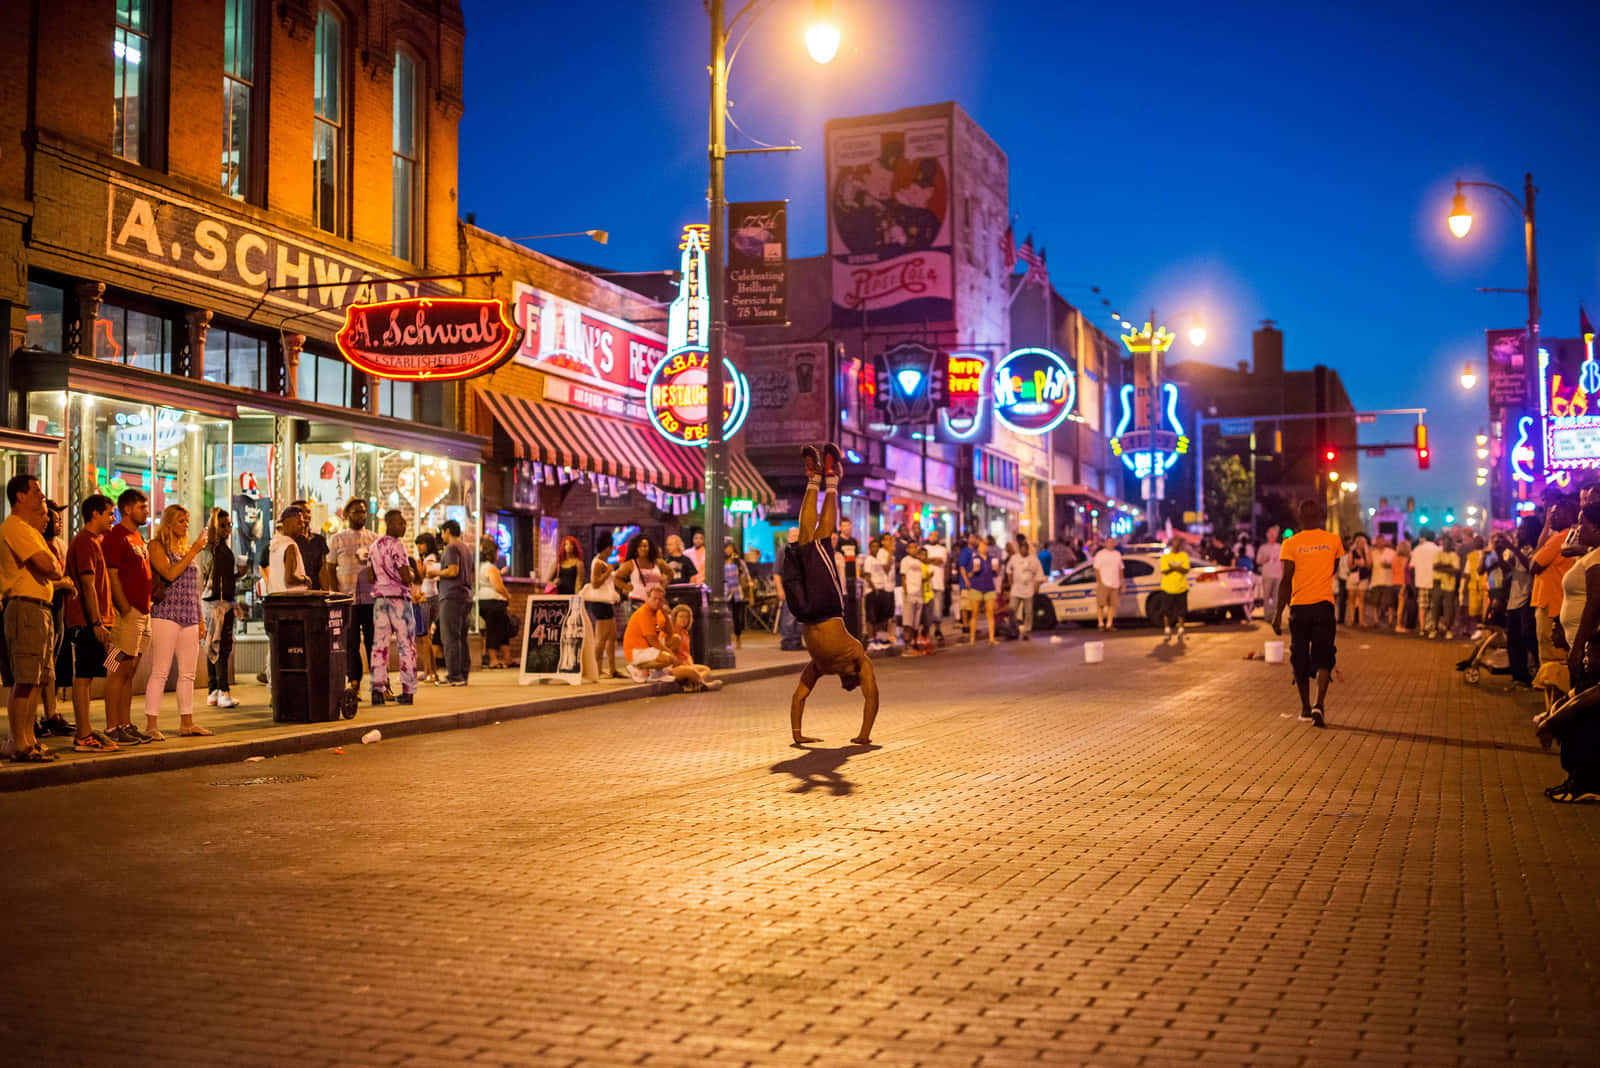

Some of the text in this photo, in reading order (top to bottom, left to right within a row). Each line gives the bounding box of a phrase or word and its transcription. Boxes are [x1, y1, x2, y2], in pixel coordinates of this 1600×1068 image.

[115, 197, 182, 260] A.
[347, 306, 500, 348] A. Schwab
[375, 352, 480, 369] ESTABLISHED 1876
